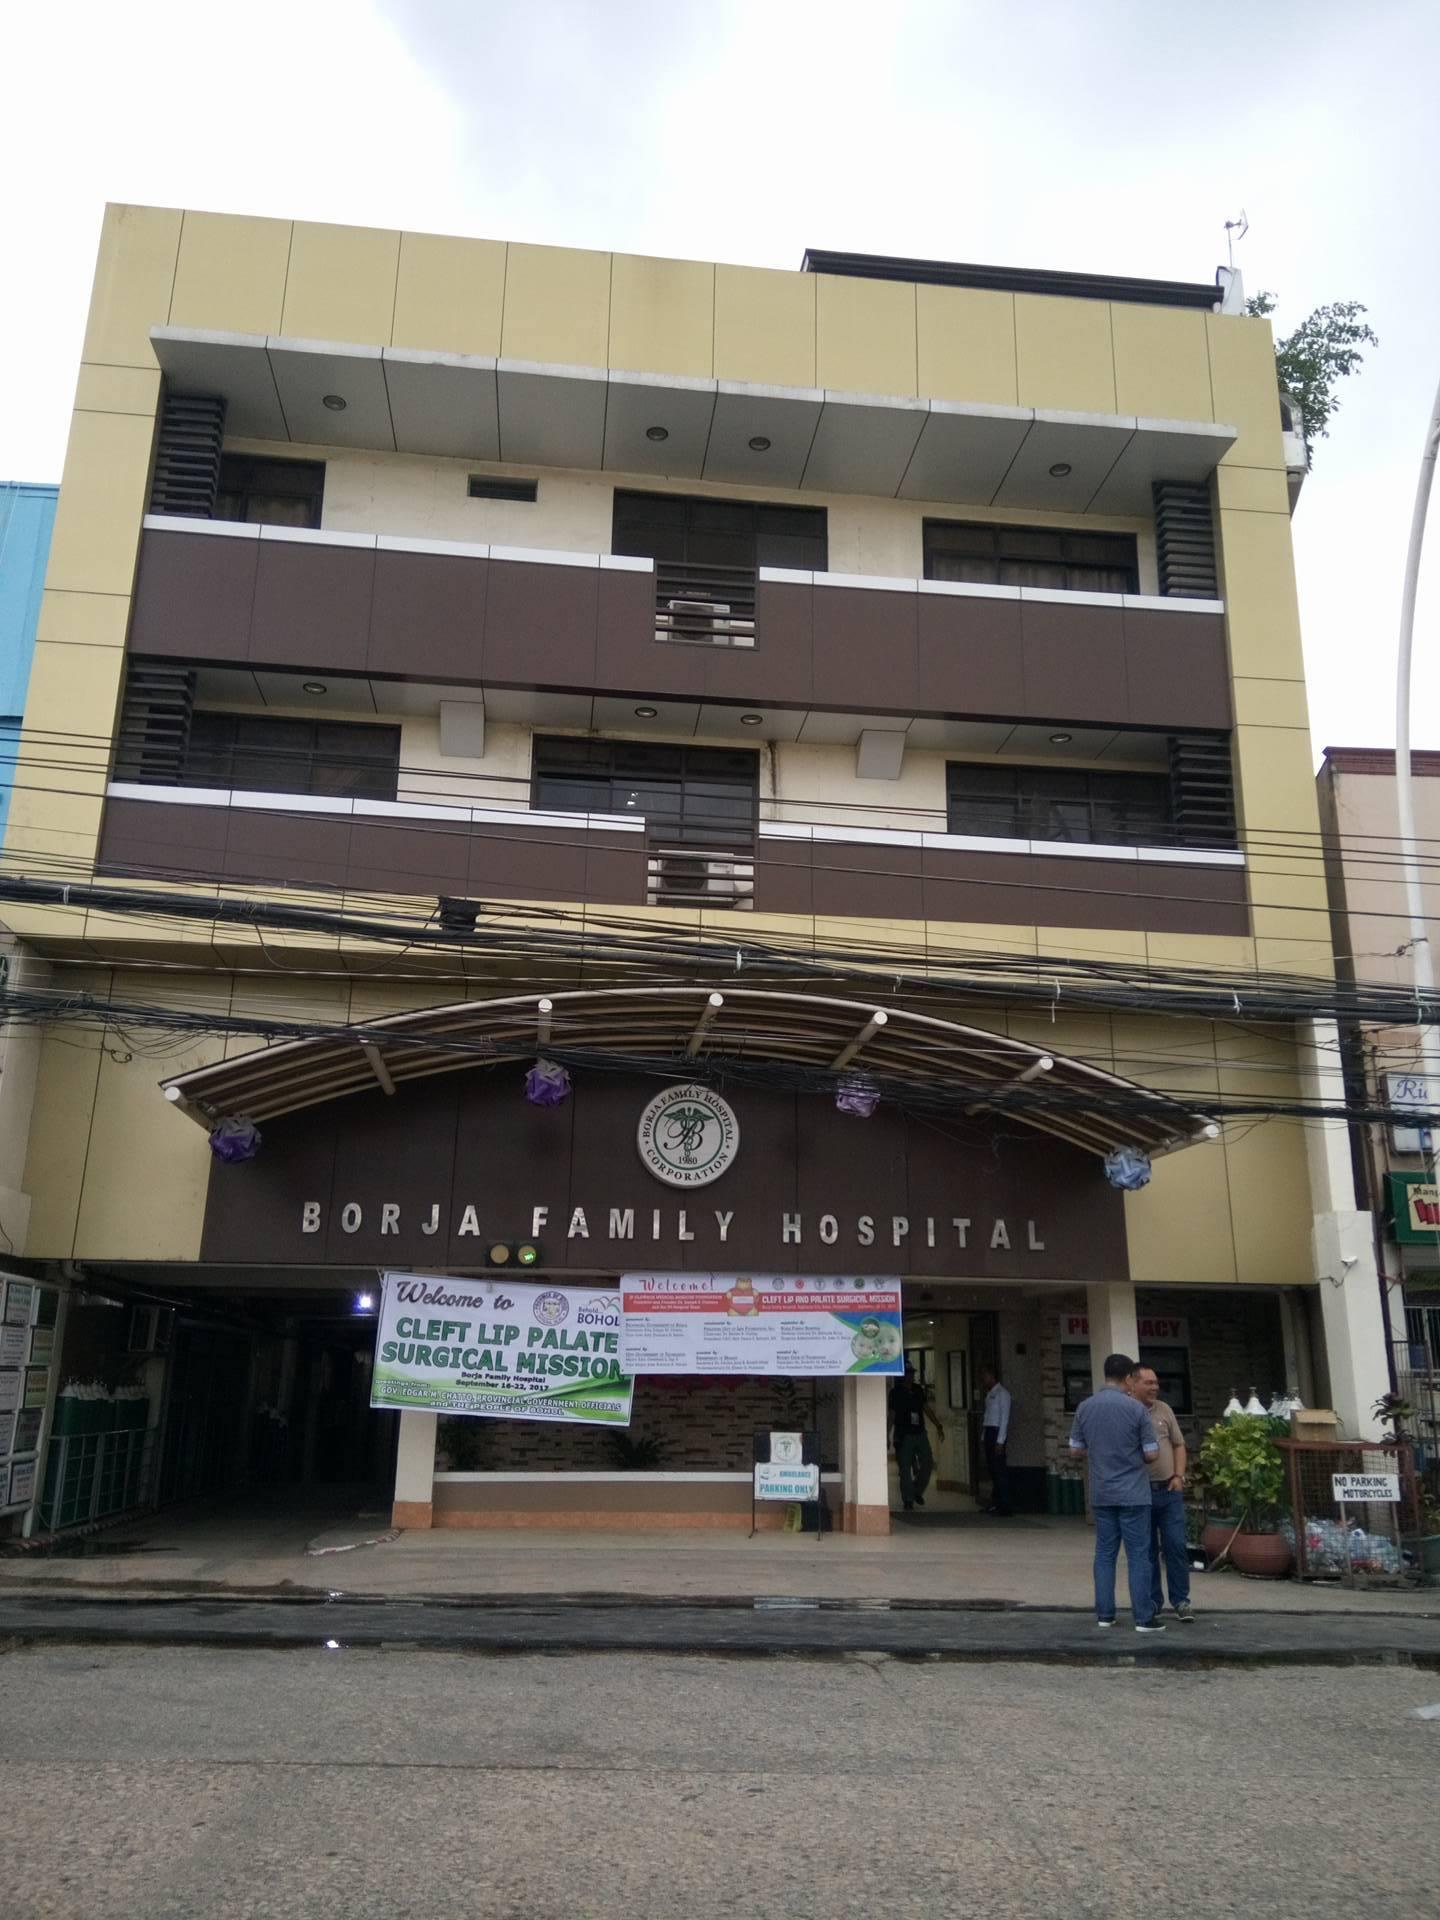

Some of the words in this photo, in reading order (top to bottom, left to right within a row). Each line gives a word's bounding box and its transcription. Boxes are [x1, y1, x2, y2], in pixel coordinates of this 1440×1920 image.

[642, 1104, 662, 1138] BORJA
[661, 1090, 703, 1106] FAMILY
[704, 1094, 733, 1143] HOSPITAL
[646, 1149, 729, 1181] CORPORATION
[678, 1156, 698, 1165] 1980
[302, 1202, 481, 1238] BORJA
[532, 1205, 735, 1242] FAMILY
[783, 1210, 1046, 1251] HOSPITAL
[396, 1280, 484, 1309] Welcome
[494, 1294, 514, 1310] to
[762, 1295, 781, 1304] CLEFT
[784, 1296, 794, 1304] LIP
[811, 1296, 835, 1304] PALATE
[837, 1296, 868, 1304] SURGICAL
[870, 1296, 896, 1304] MISSION
[577, 1313, 620, 1326] BOHOL
[396, 1317, 472, 1343] CLEFT
[477, 1323, 520, 1347] LIP
[527, 1327, 619, 1354] PALATE
[381, 1341, 508, 1372] SURGICAL
[516, 1351, 625, 1381] MISSION
[461, 1371, 483, 1381] Borja
[485, 1373, 511, 1382] Family
[513, 1375, 546, 1384] Hospital
[455, 1379, 499, 1389] September
[529, 1384, 549, 1392] 2017
[527, 1398, 579, 1408] GOVERNMENT
[581, 1401, 622, 1412] OFFICIALS
[1334, 1476, 1347, 1487] NO
[1350, 1476, 1388, 1487] PARKING
[760, 1484, 793, 1494] PARKING
[794, 1484, 814, 1494] ONLY
[1343, 1488, 1393, 1498] MOTORCYCLES
